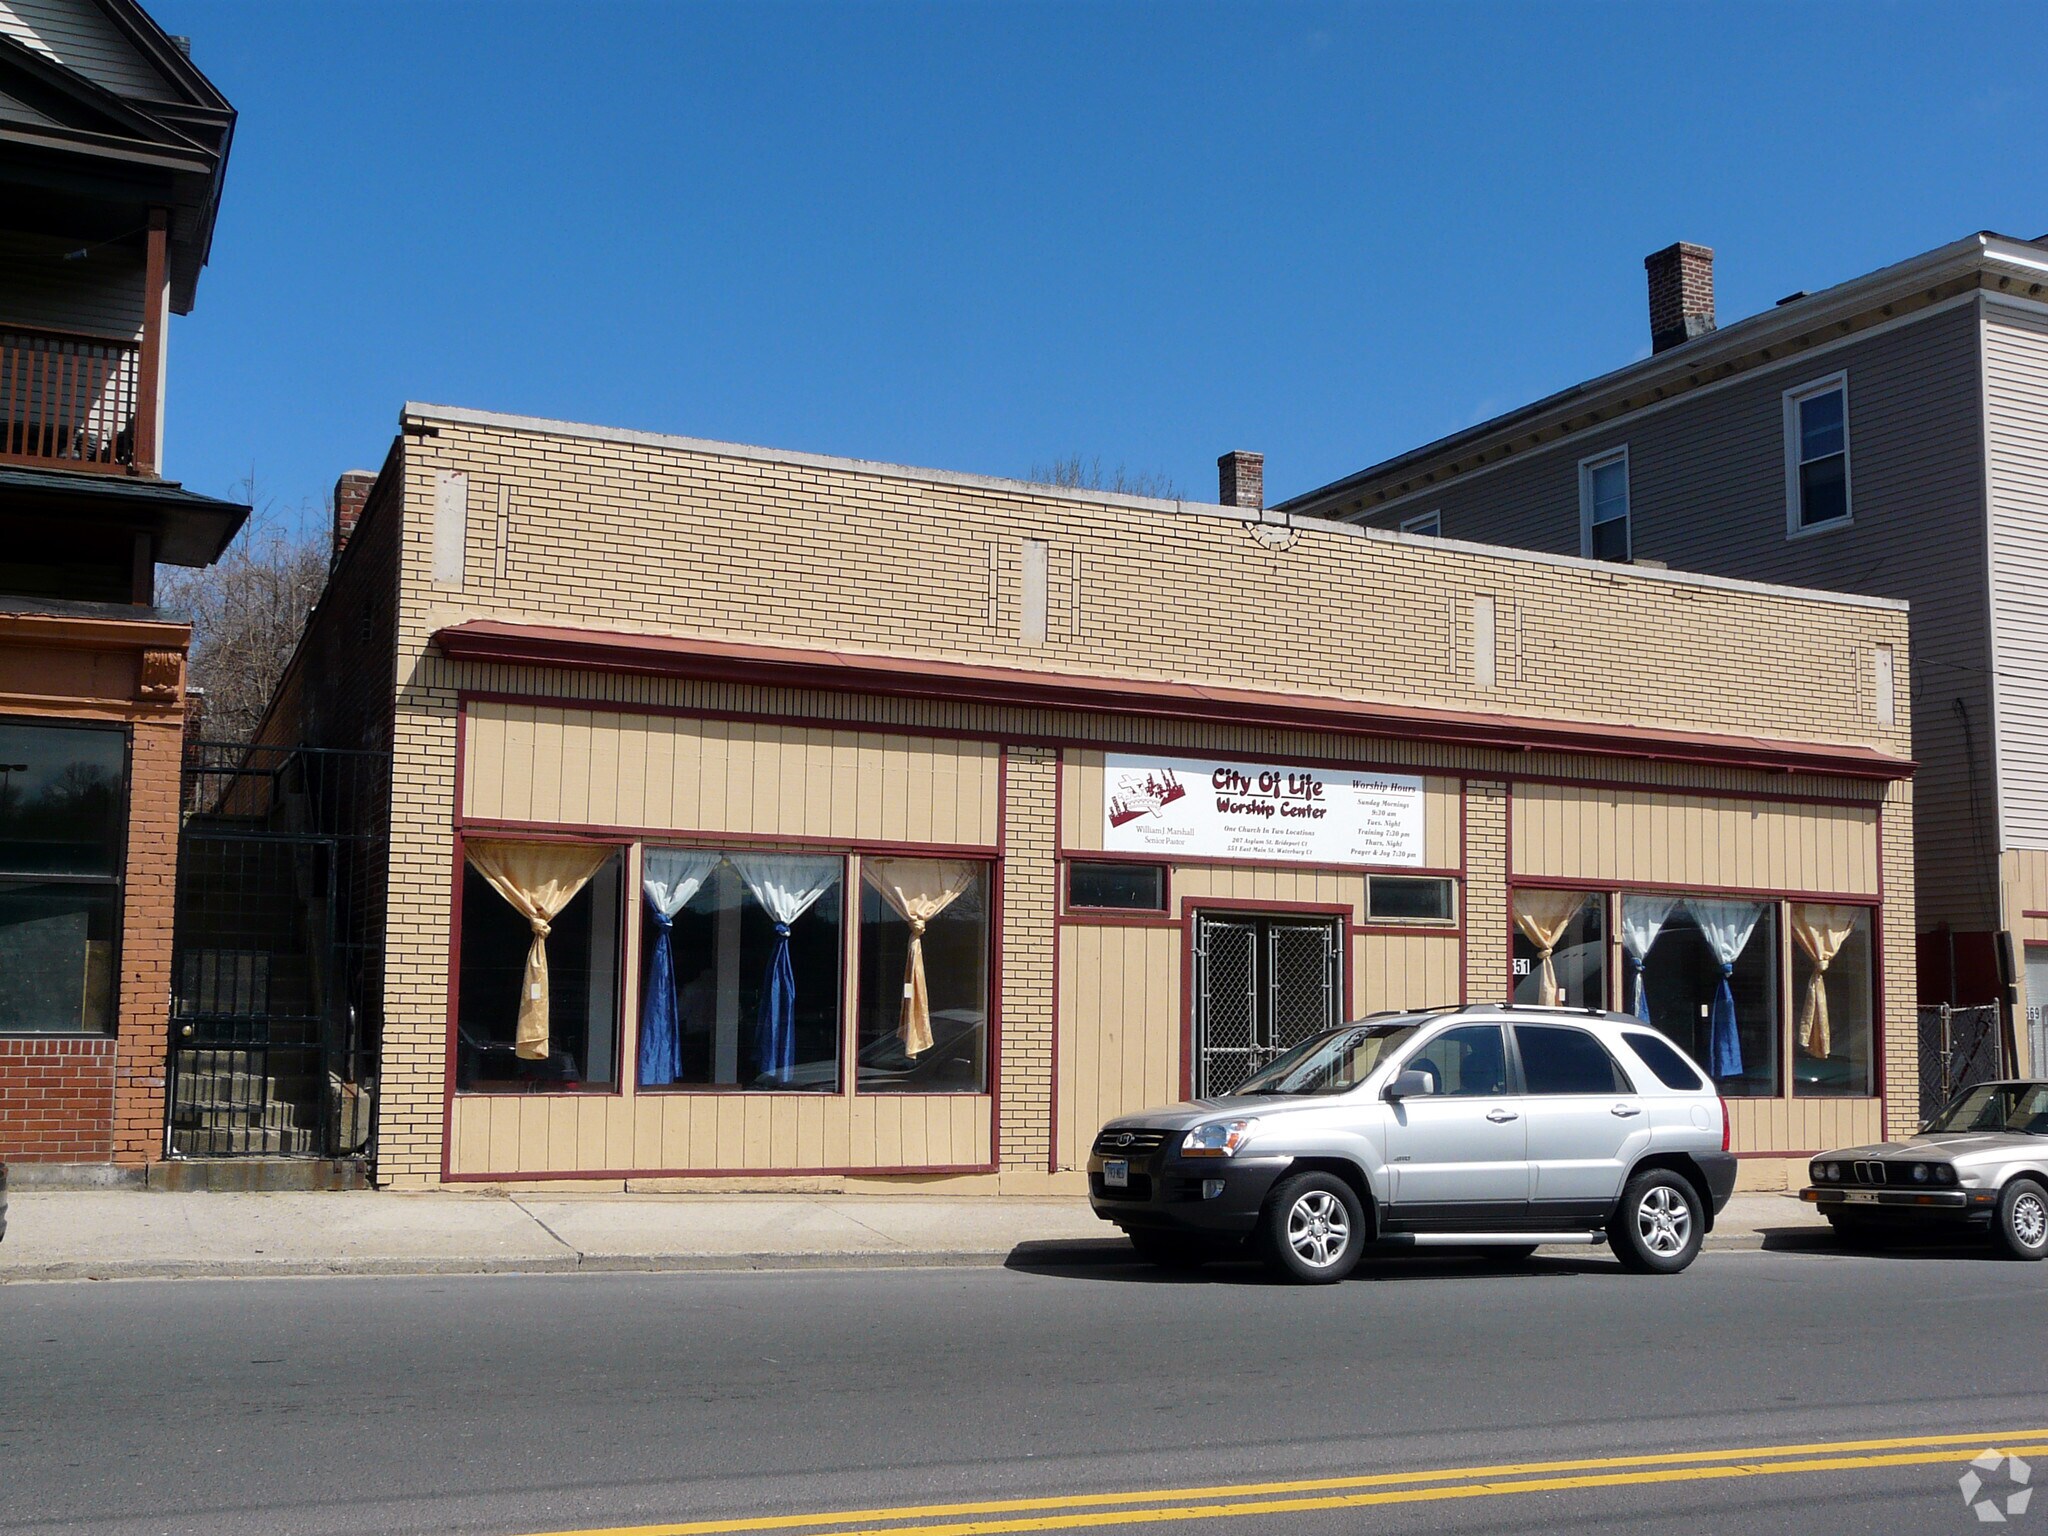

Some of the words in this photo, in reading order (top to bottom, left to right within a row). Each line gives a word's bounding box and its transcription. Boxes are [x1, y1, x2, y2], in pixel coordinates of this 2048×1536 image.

[1212, 768, 1251, 796] City
[1258, 771, 1281, 799] Of
[1288, 773, 1323, 801] Life
[1352, 779, 1388, 792] Worship
[1390, 782, 1416, 793] Hours
[1216, 796, 1275, 819] Worship
[1280, 801, 1327, 819] Center
[1357, 799, 1380, 807] Sunday
[1381, 800, 1409, 809] Mornings
[1384, 820, 1401, 828] Night
[1136, 825, 1162, 834] William
[1167, 827, 1195, 836] Marshall
[1238, 825, 1261, 833] Church
[1271, 826, 1284, 835] Two
[1285, 828, 1315, 836] Locations
[1358, 828, 1384, 837] Training
[1400, 831, 1410, 839] pm
[1144, 835, 1165, 844] Senior
[1165, 837, 1185, 845] Pastor
[1385, 840, 1403, 848] Night
[1276, 847, 1305, 856] Waterbury
[1350, 848, 1371, 857] Prayer
[1372, 849, 1378, 857] &
[1378, 849, 1391, 858] Joy
